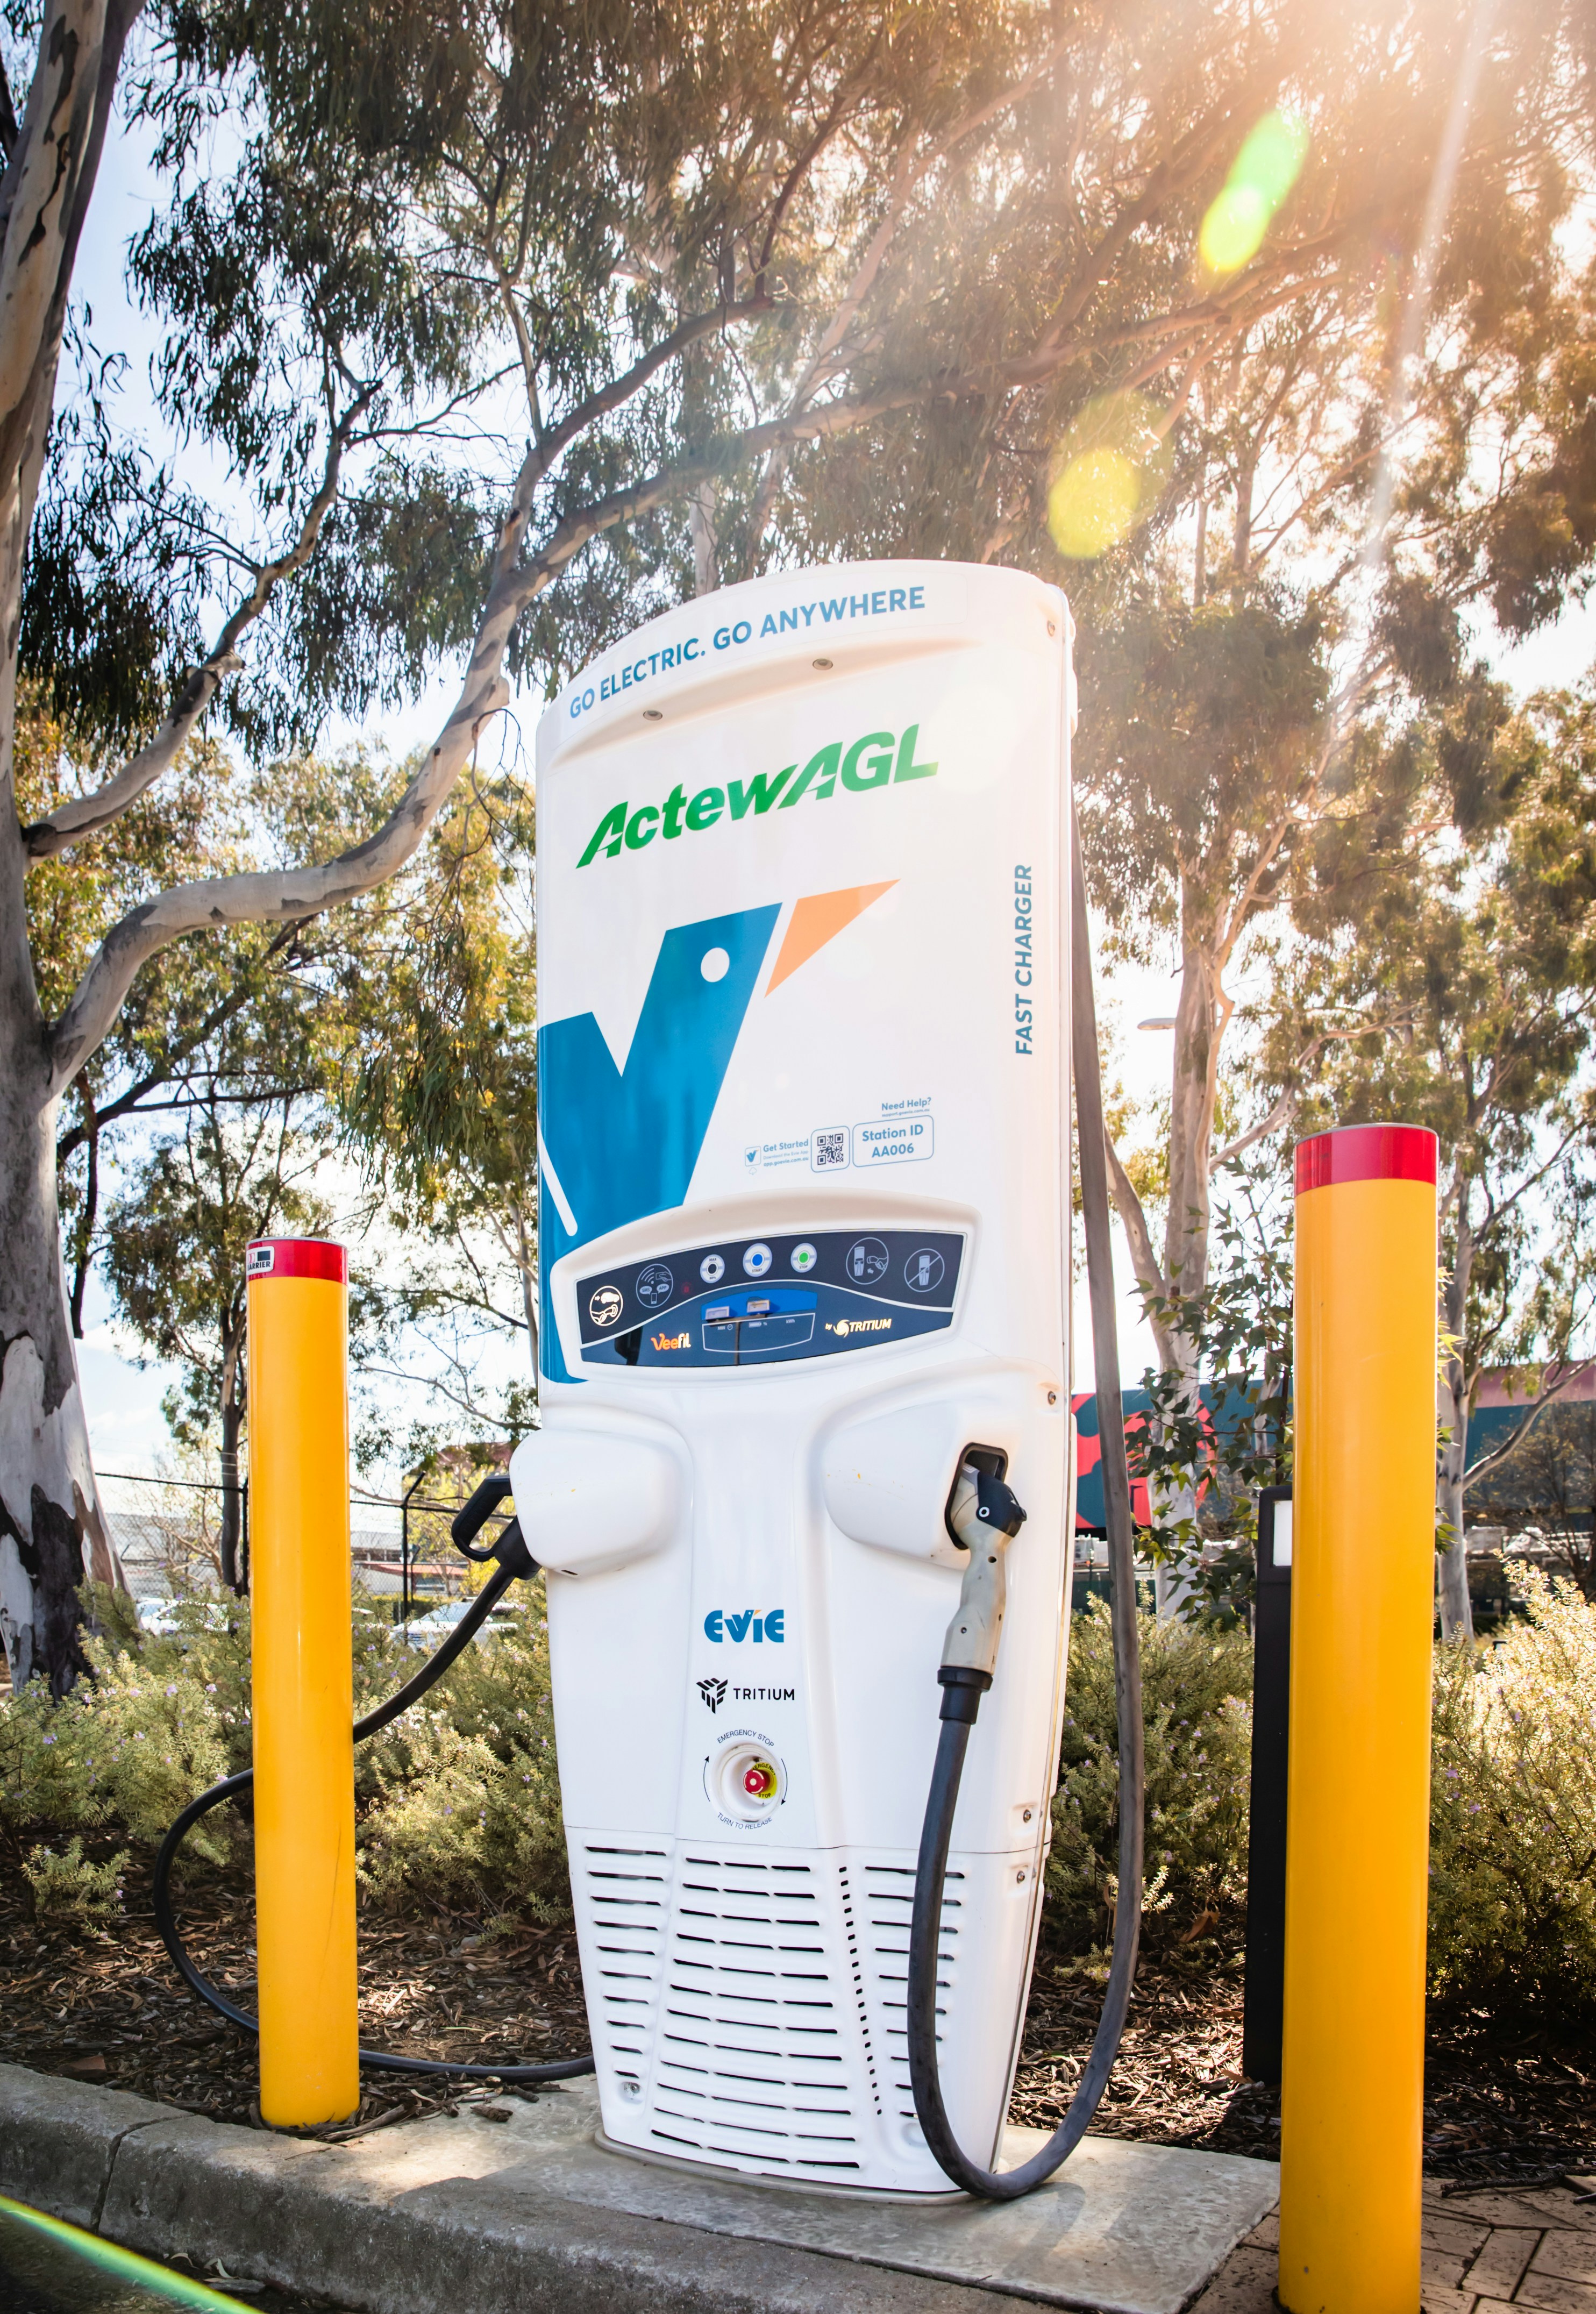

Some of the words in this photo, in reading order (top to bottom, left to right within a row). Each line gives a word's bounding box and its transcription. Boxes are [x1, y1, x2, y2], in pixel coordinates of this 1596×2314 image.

[570, 688, 595, 718] GO
[601, 638, 706, 702] ELECTRIC.
[713, 621, 752, 650] GO
[760, 586, 925, 638] ANYWHERE
[575, 723, 938, 870] ActewAGL
[1015, 865, 1032, 986] CHARGER
[1015, 993, 1032, 1055] FAST
[881, 1100, 904, 1111] Need
[907, 1097, 931, 1108] Help?
[862, 1128, 906, 1142] Station
[910, 1124, 924, 1136] ID
[763, 1144, 776, 1152] Get
[779, 1138, 809, 1150] Started
[872, 1143, 914, 1158] AA006
[764, 1157, 809, 1167] app.goevie.com.au
[849, 1318, 892, 1333] TRITIUM
[650, 1333, 692, 1351] Veefil
[733, 1688, 795, 1700] TRITIUM
[717, 1729, 757, 1744] EMERGENCY
[757, 1733, 774, 1747] STOP
[717, 1812, 734, 1827] TURN
[745, 1817, 773, 1829] RELEASE
